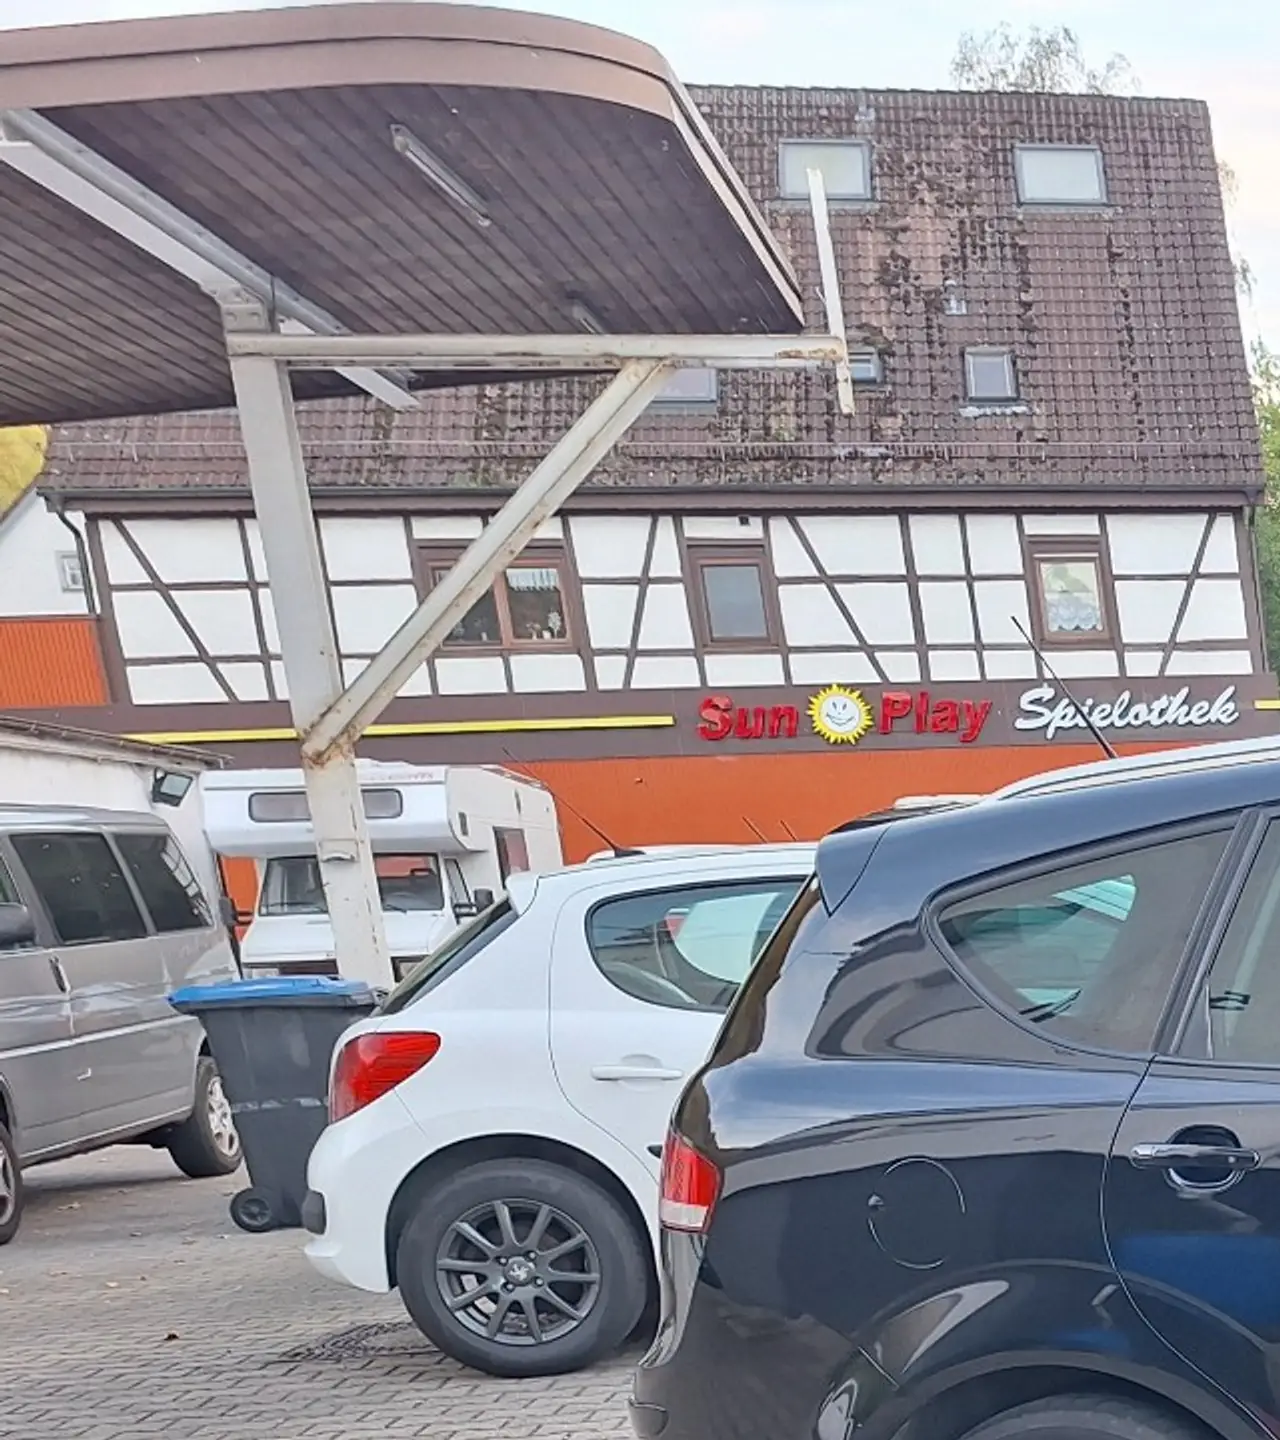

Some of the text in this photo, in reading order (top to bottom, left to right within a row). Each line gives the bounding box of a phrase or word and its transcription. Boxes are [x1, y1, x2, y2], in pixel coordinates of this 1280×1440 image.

[696, 683, 1240, 744] Sun Play Spielothek
